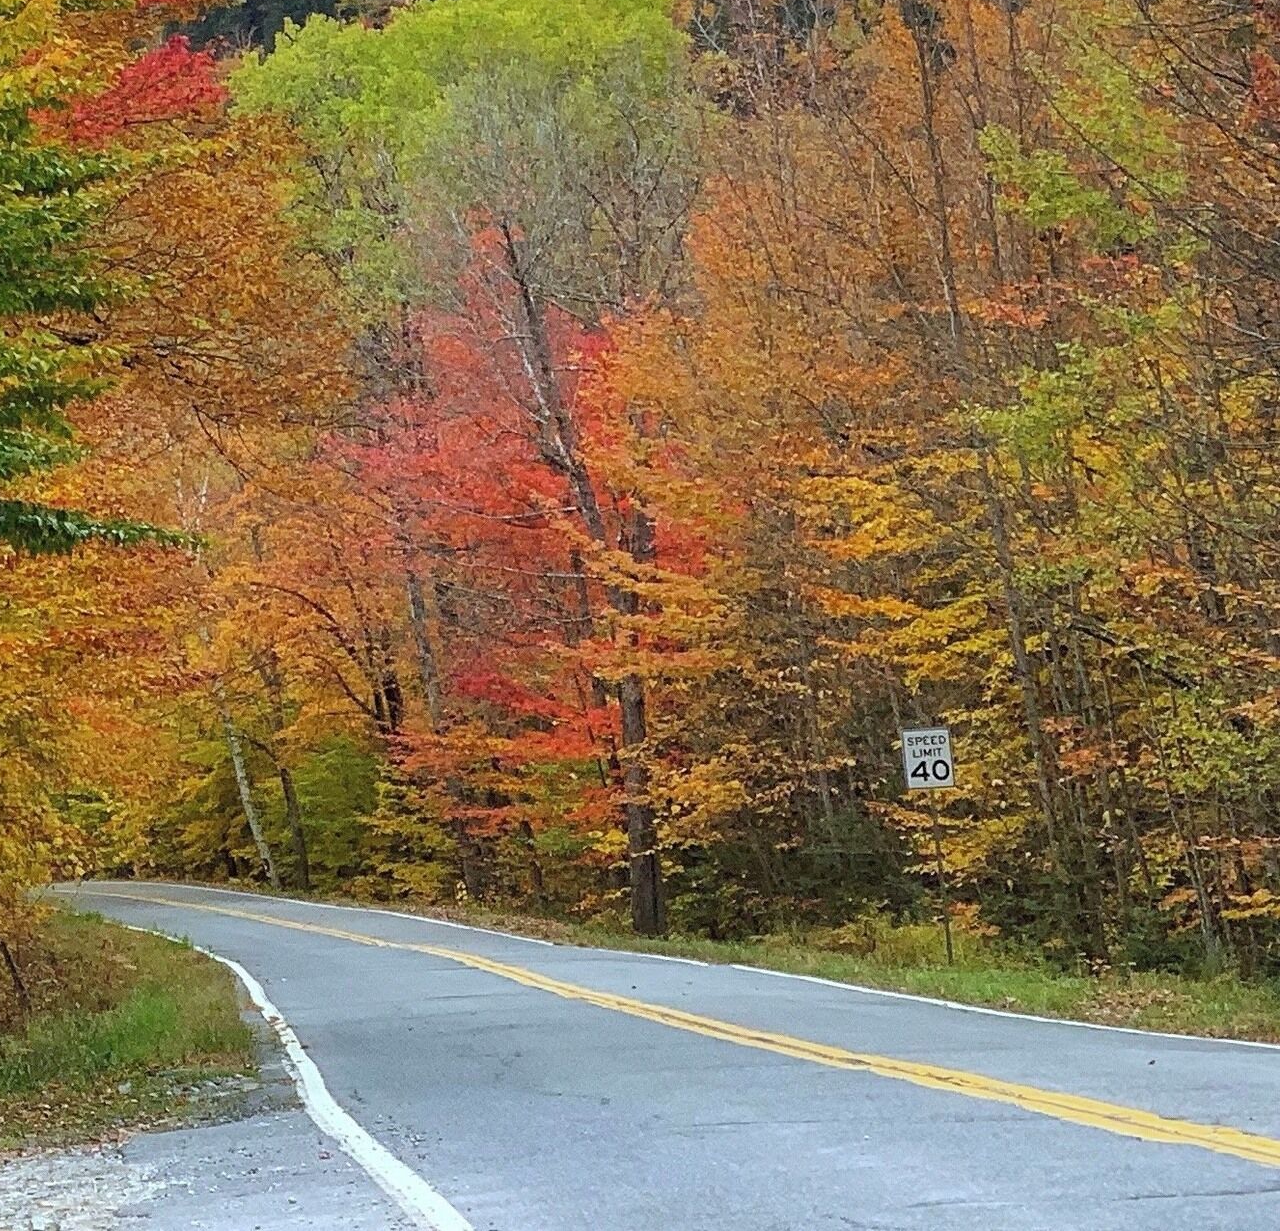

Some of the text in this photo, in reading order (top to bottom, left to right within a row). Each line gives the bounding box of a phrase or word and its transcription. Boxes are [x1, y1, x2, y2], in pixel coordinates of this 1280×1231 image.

[907, 735, 946, 746] SPEED
[912, 748, 942, 758] LIMIT
[911, 759, 950, 781] 40
